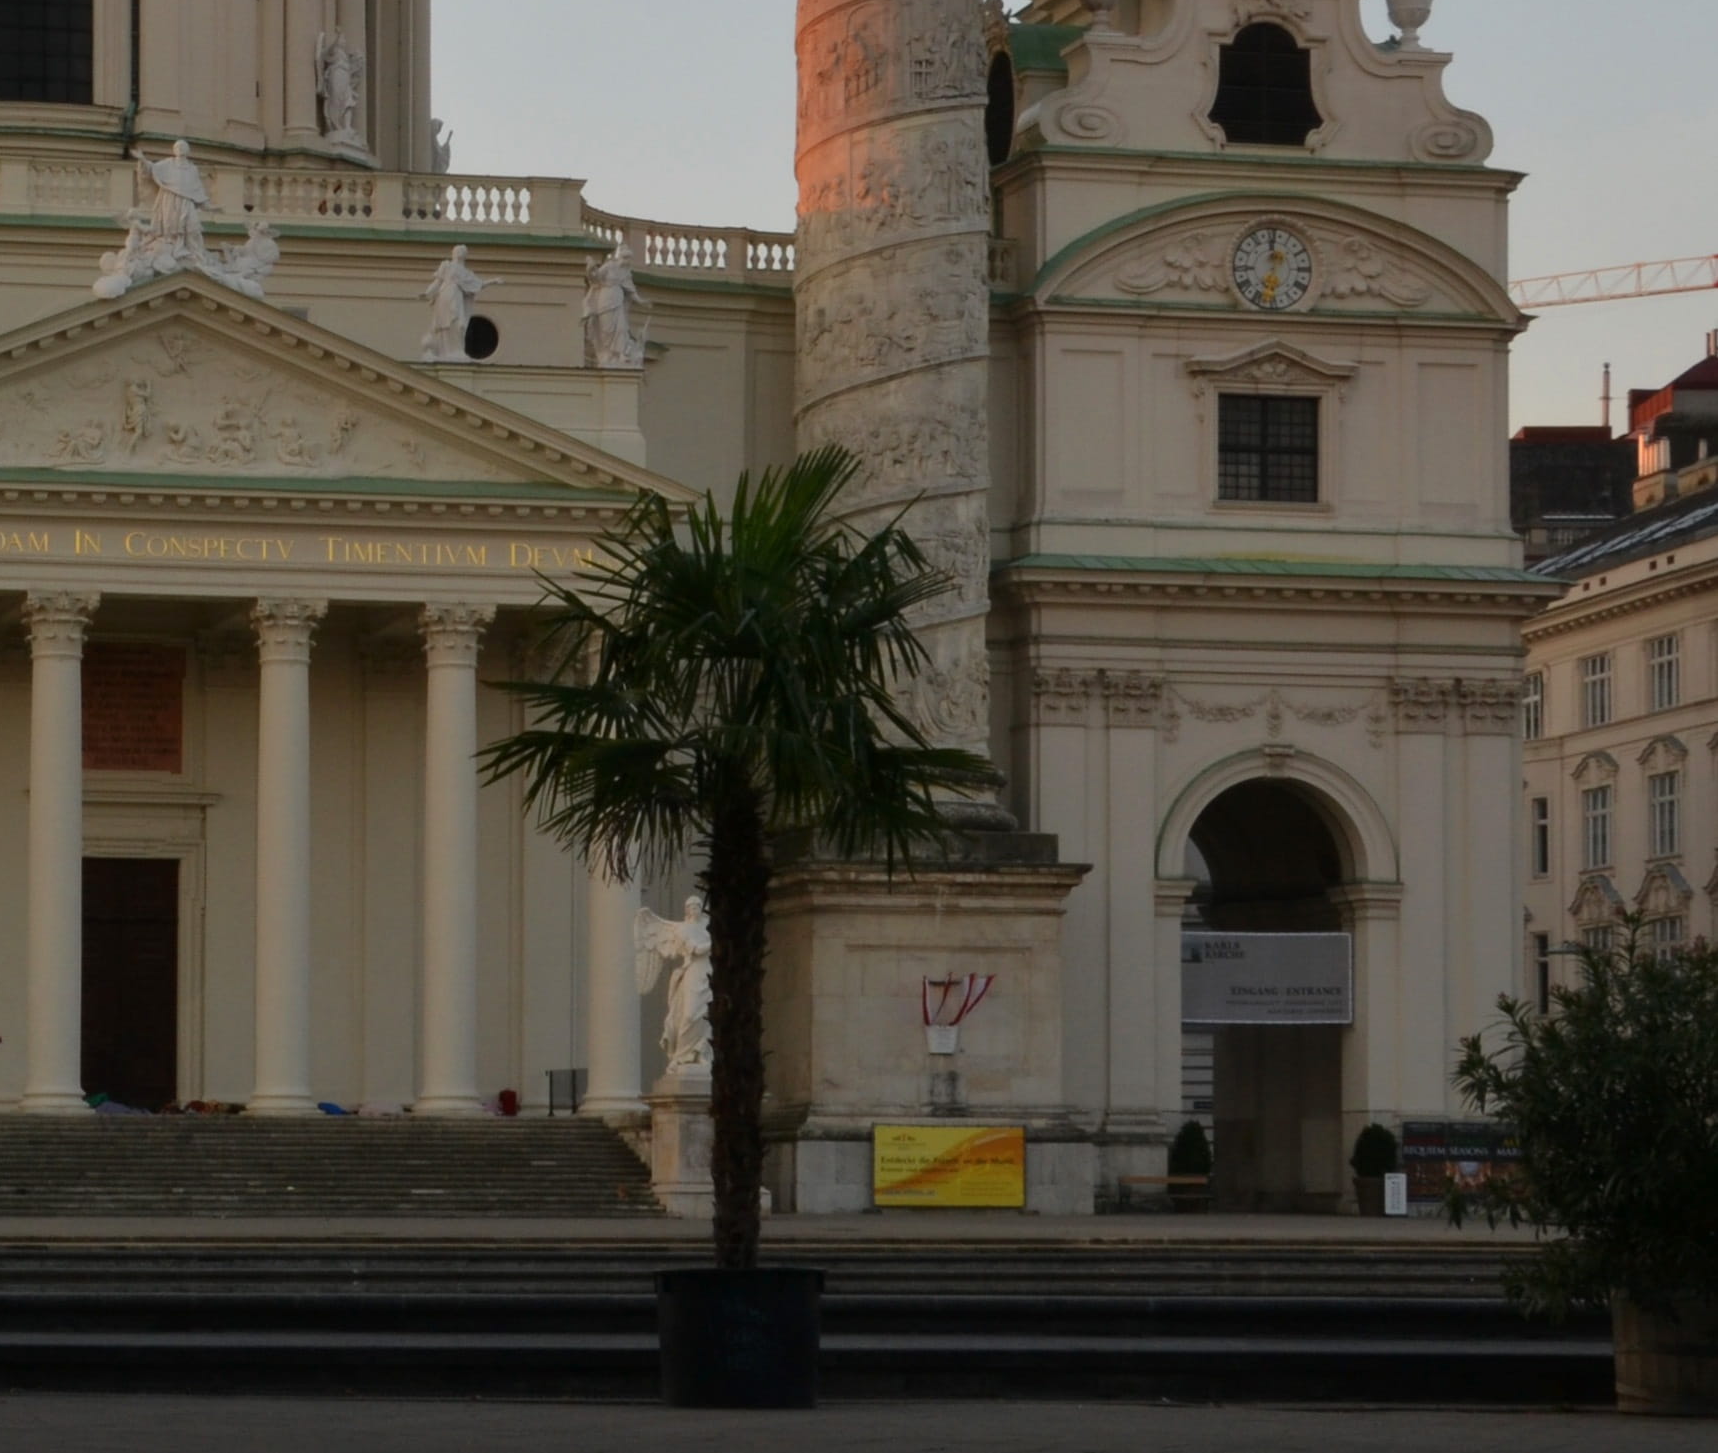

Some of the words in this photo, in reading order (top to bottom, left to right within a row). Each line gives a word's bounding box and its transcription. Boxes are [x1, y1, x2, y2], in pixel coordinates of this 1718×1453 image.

[73, 529, 102, 555] IN
[123, 531, 296, 562] CONSPECTV
[319, 537, 487, 567] TIMENTIVM
[1230, 986, 1279, 996] EINGANG
[1286, 986, 1343, 996] ENTRANCE
